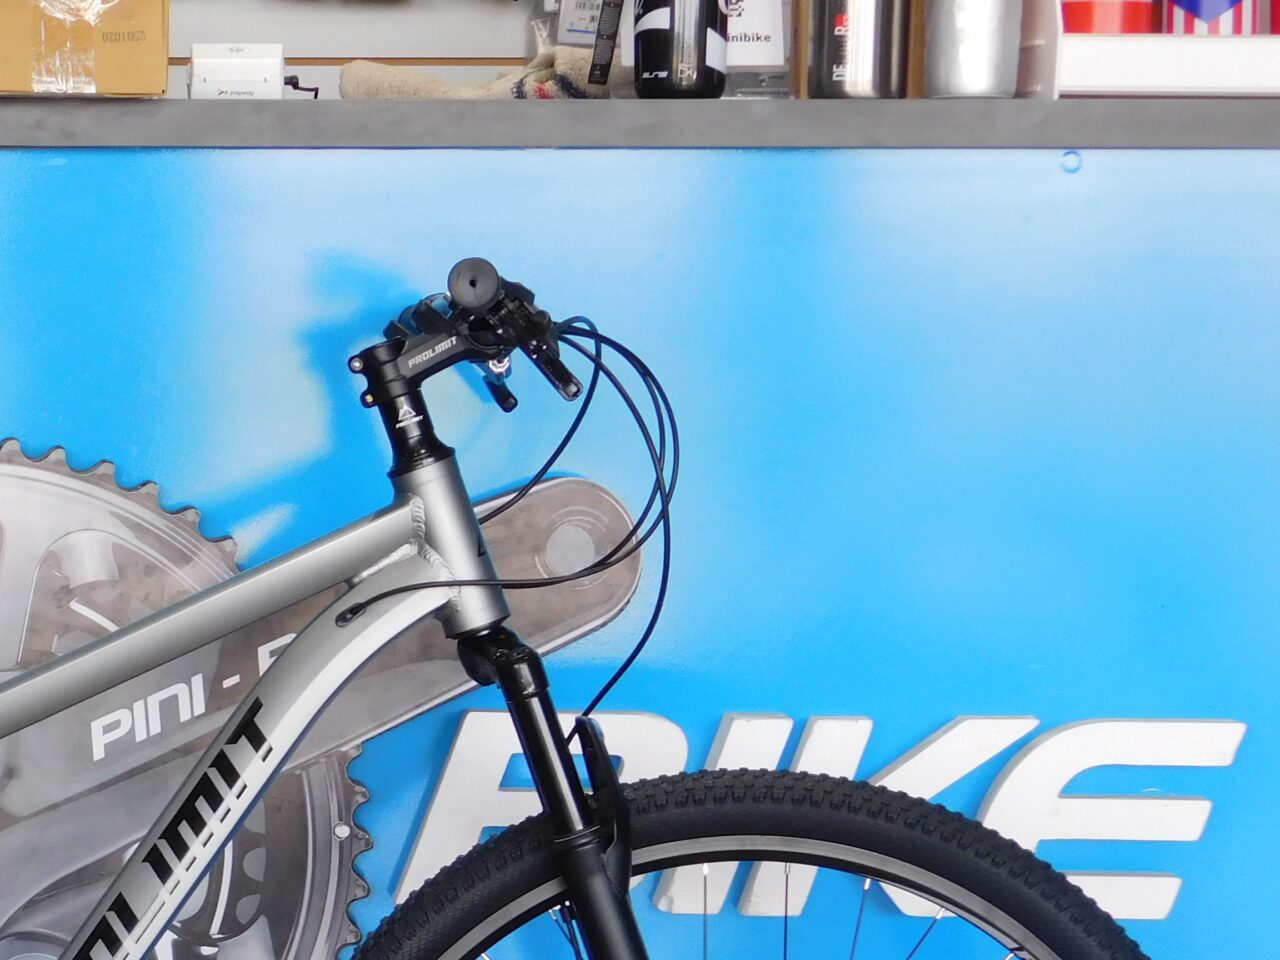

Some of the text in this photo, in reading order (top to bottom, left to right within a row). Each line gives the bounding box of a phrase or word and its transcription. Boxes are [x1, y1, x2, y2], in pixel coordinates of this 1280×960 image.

[727, 32, 771, 43] inibike
[408, 335, 458, 369] PROLIMIT
[91, 673, 206, 762] PINI
